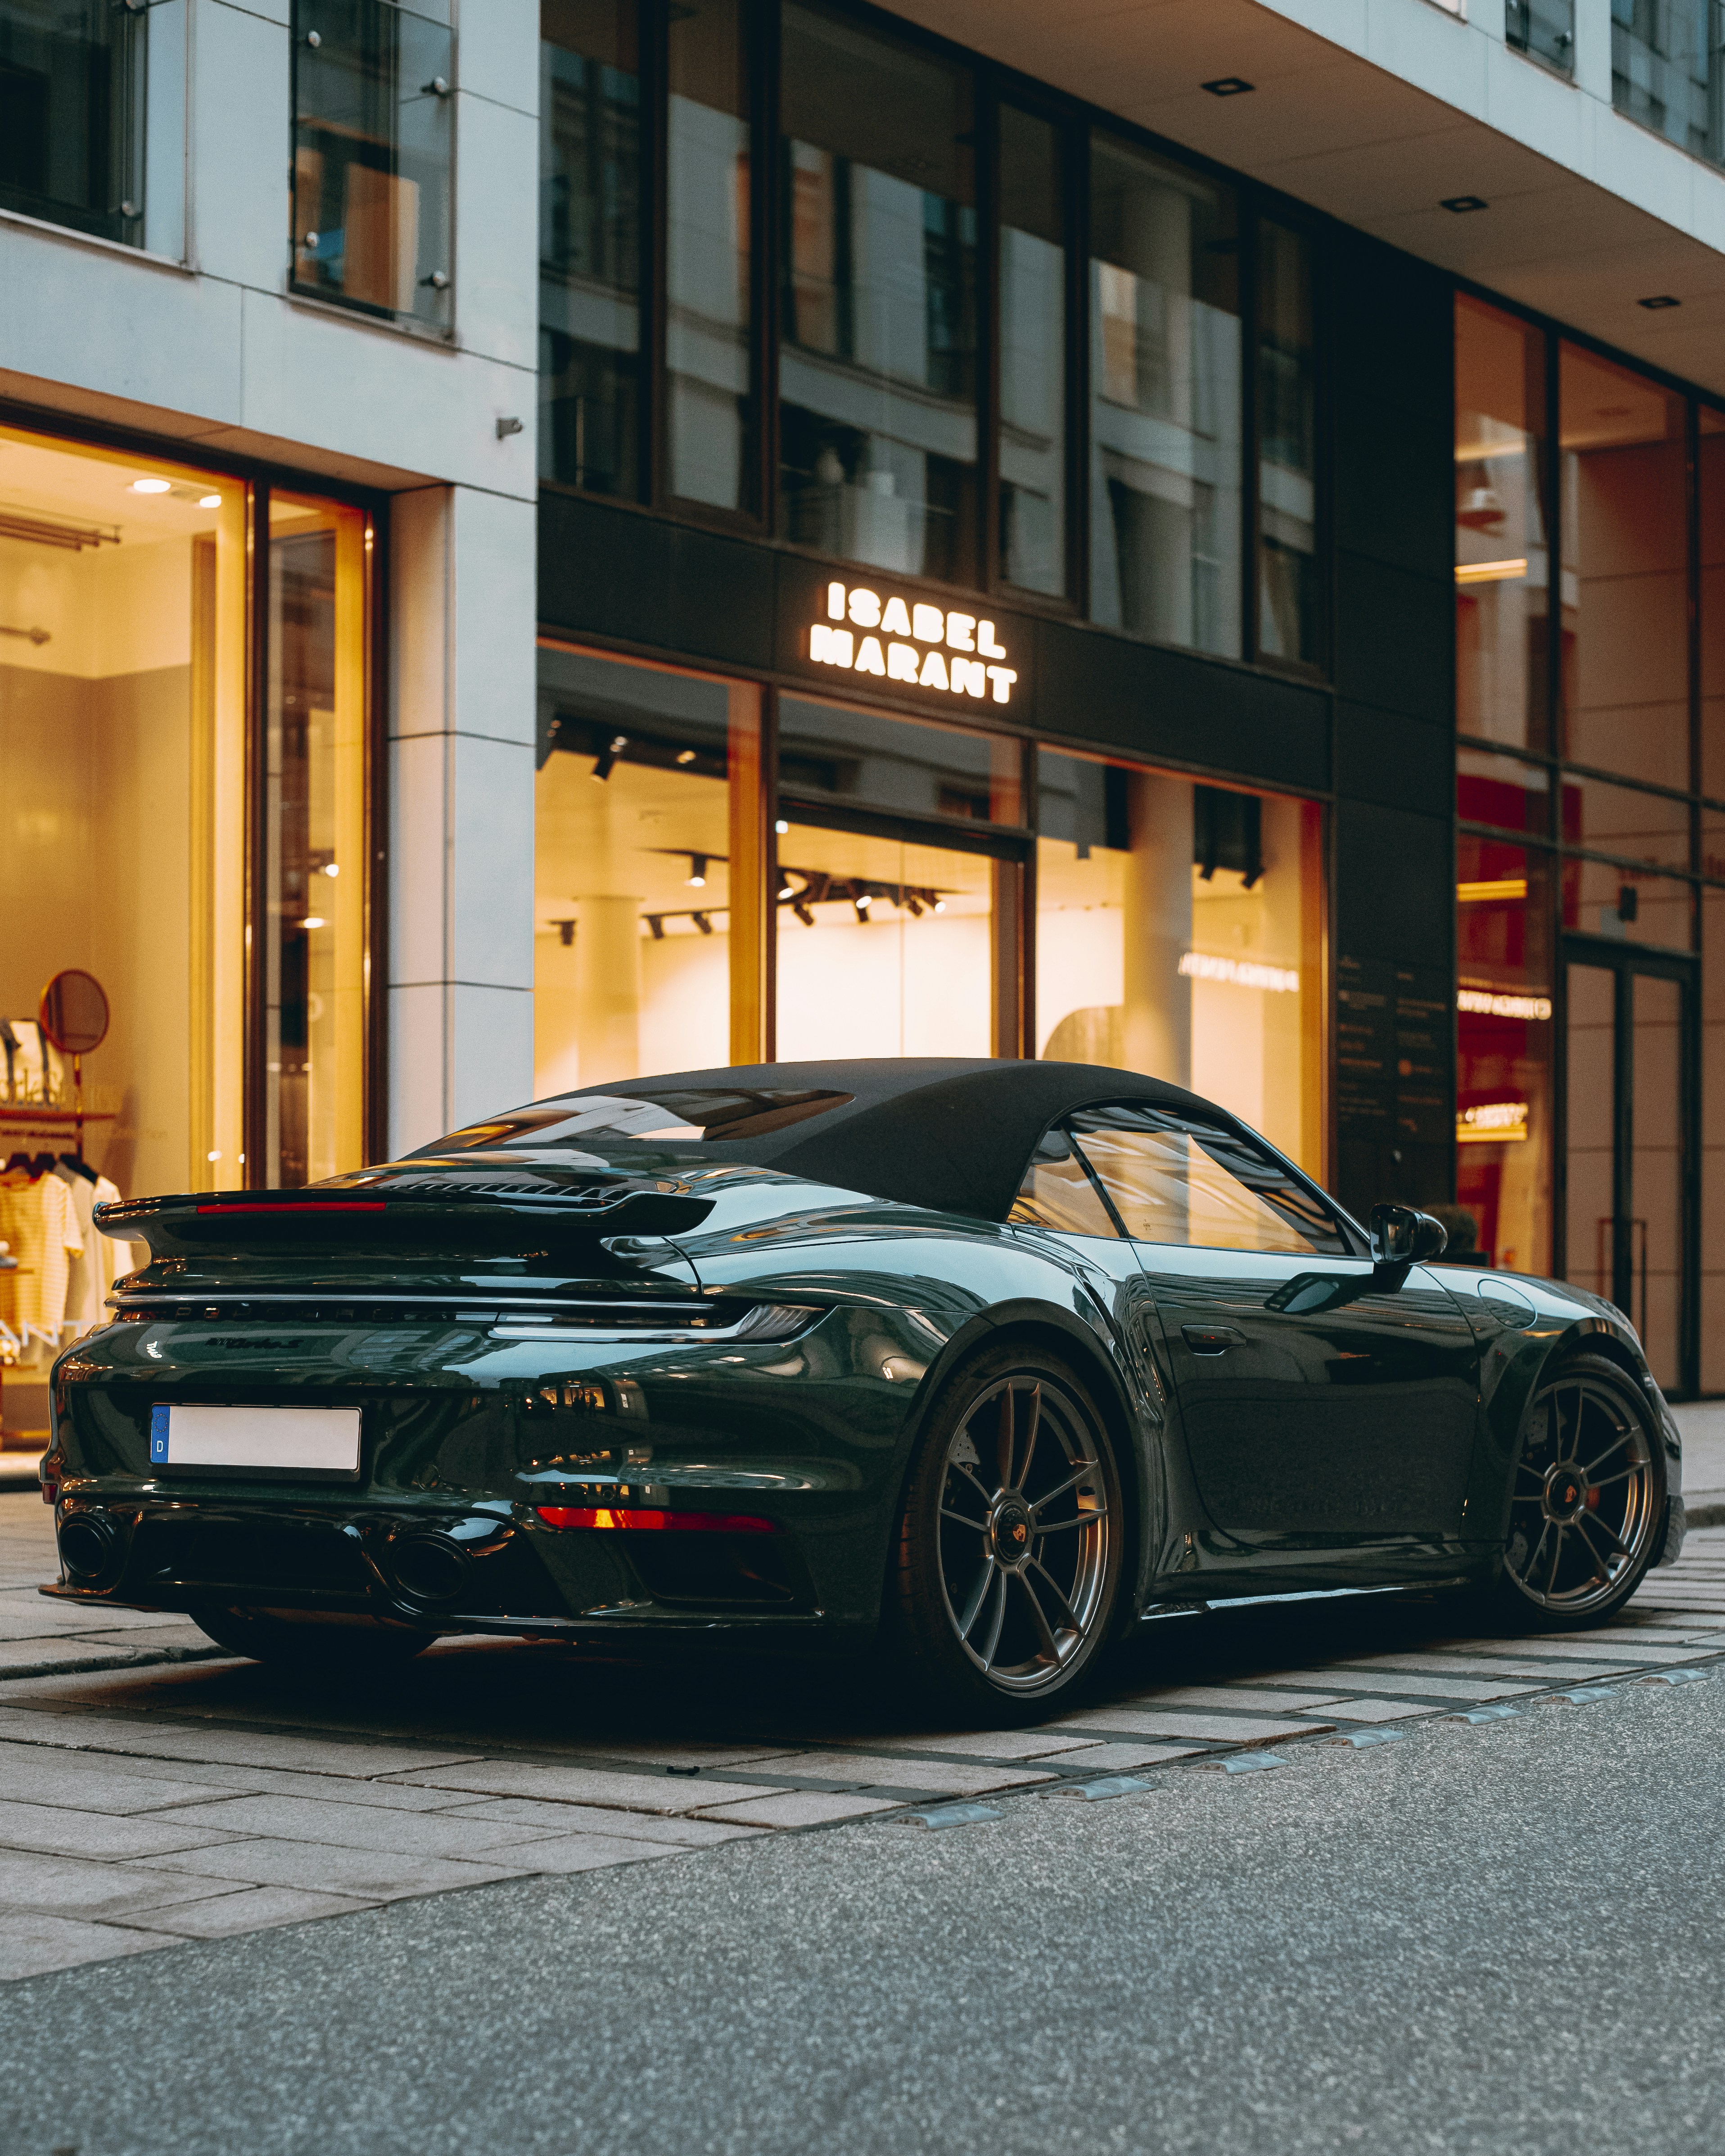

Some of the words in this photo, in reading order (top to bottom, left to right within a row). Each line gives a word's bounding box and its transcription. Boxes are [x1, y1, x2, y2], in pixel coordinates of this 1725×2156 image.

[827, 582, 1006, 660] ISABEL
[810, 624, 1017, 704] MARANT
[279, 1339, 304, 1349] S
[157, 1440, 163, 1452] D
